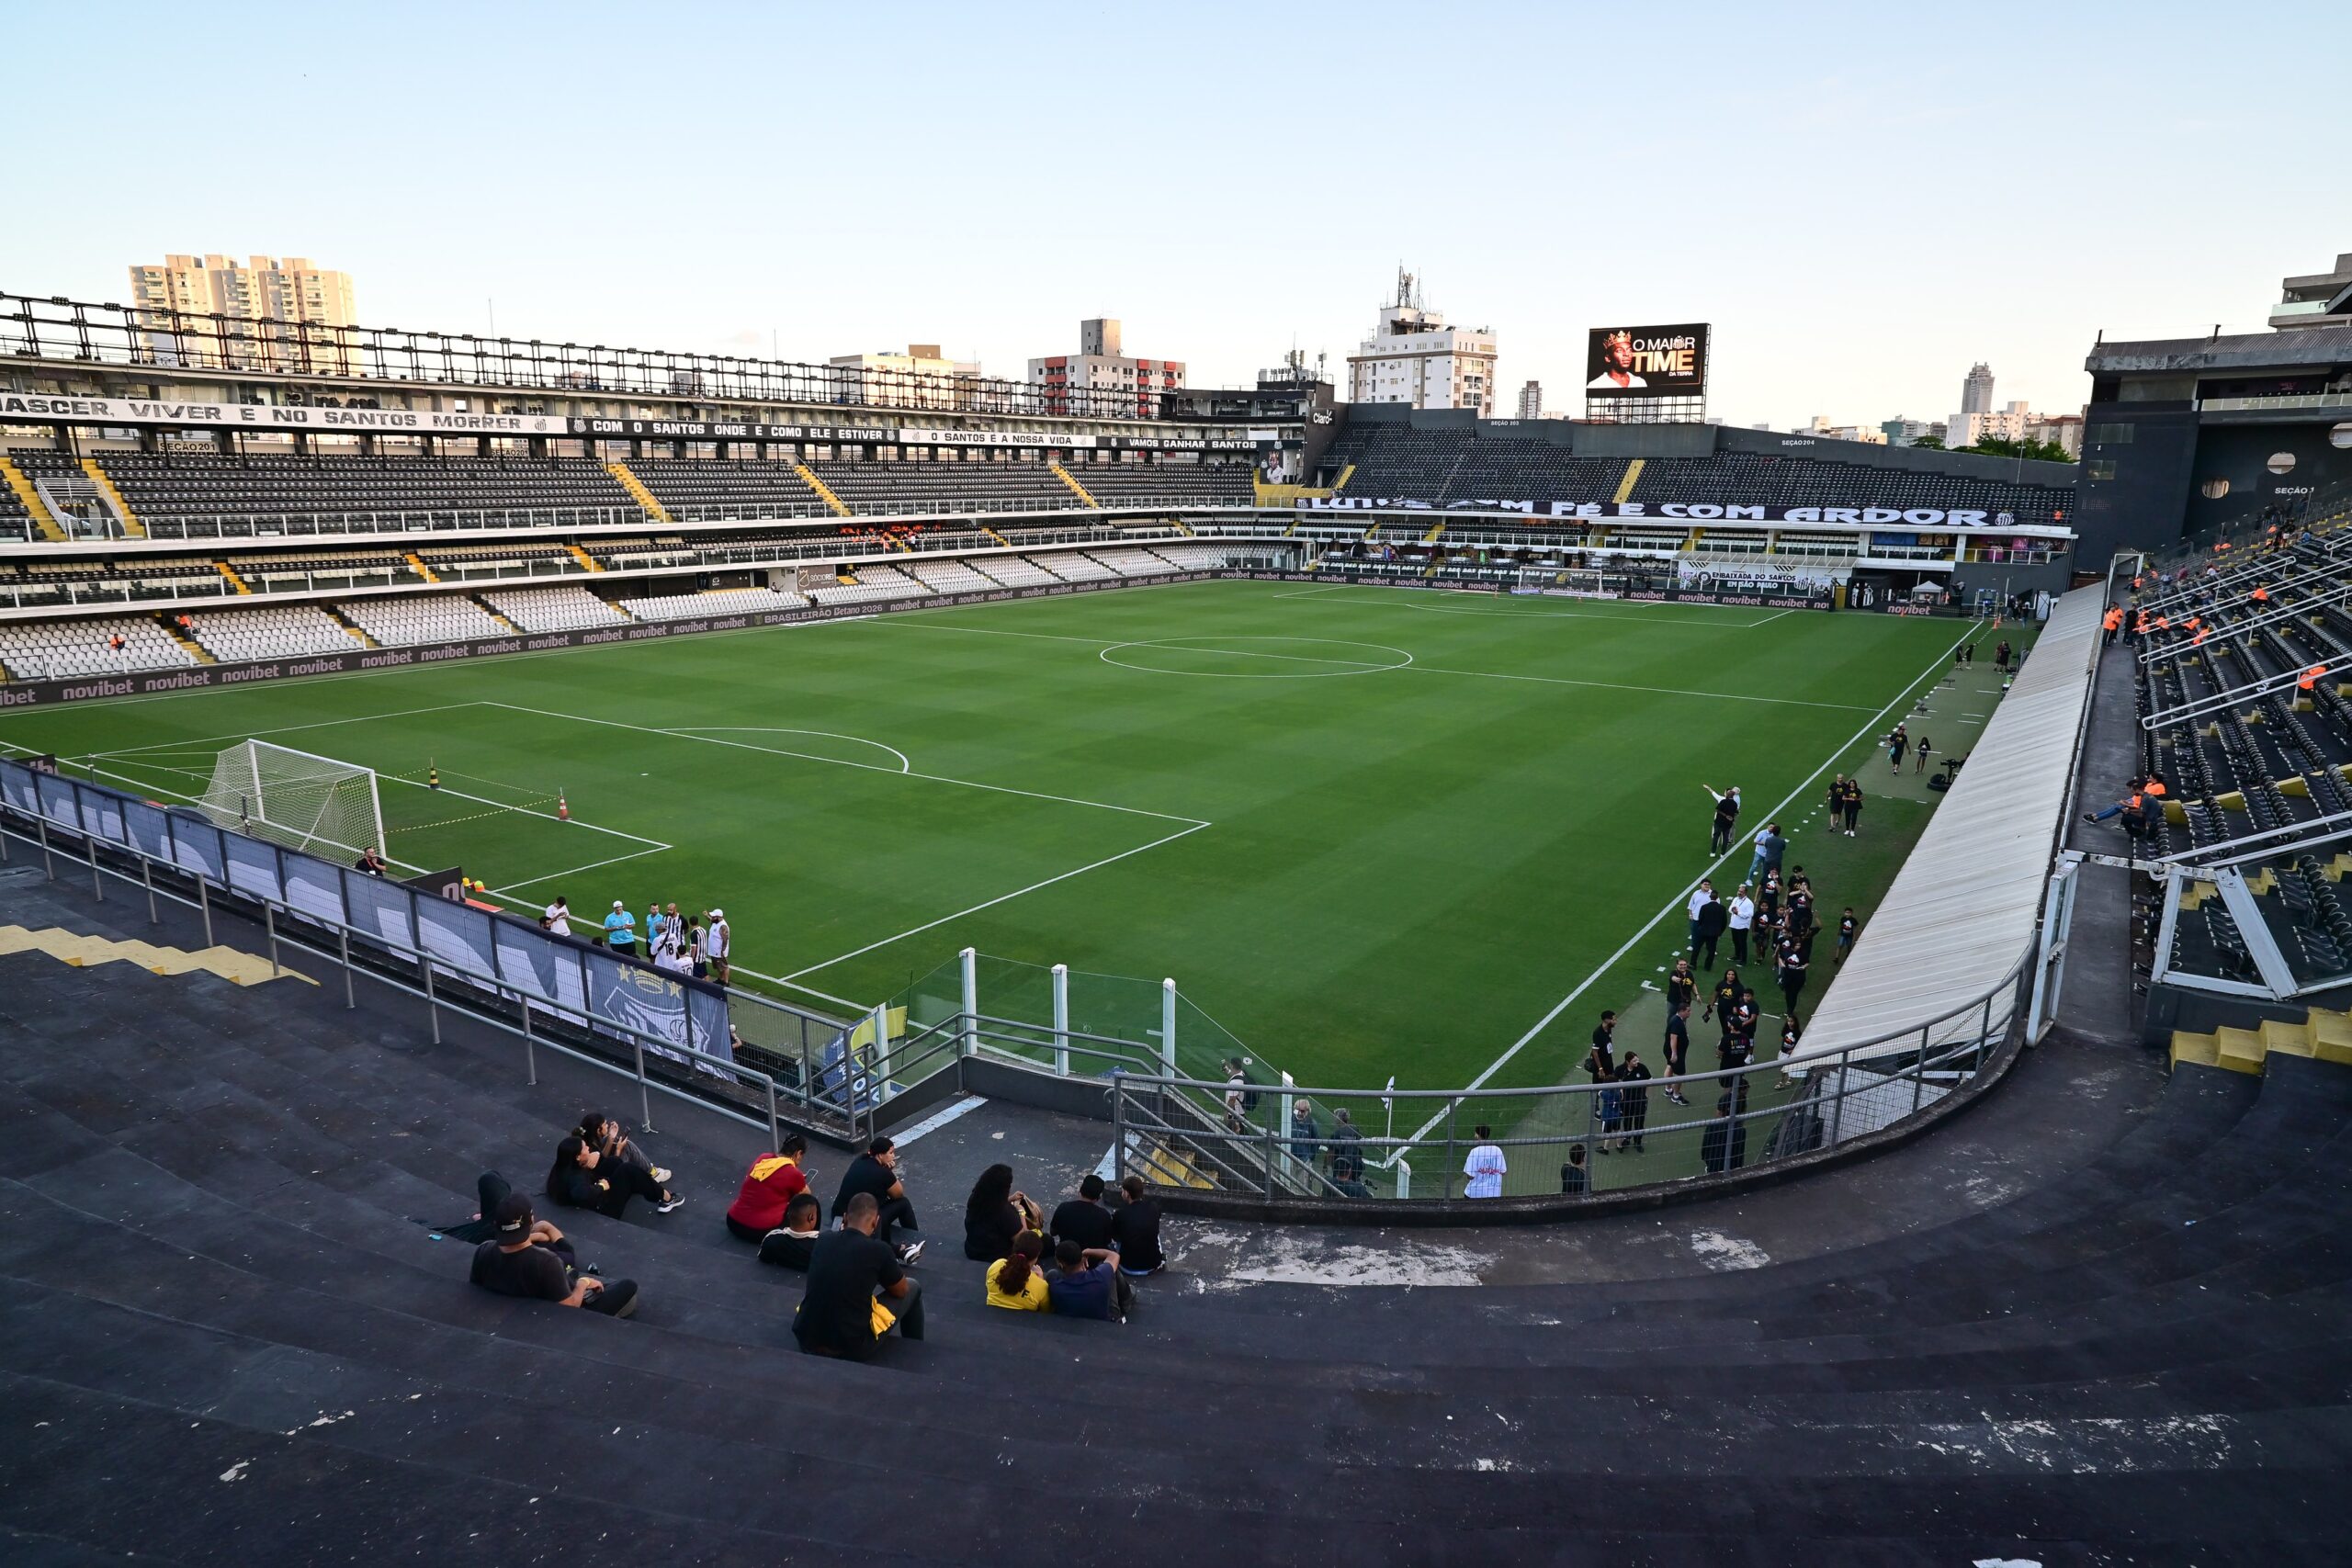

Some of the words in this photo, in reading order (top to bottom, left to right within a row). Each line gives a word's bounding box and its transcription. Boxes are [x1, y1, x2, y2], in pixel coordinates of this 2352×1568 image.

[1633, 339, 1645, 351] O
[1633, 350, 1694, 372] TIME
[0, 398, 114, 417] ASCER,
[129, 403, 221, 420] VIVER
[241, 408, 255, 422] E
[273, 409, 308, 423] NO
[325, 411, 417, 426] SANTOS
[433, 414, 521, 429] MORRER
[1313, 412, 1330, 424] Claro
[593, 421, 623, 433] COM
[633, 422, 642, 433] O
[652, 423, 705, 434] SANTOS
[715, 424, 746, 436] ONDE
[755, 425, 763, 436] E
[771, 426, 802, 437] COMO
[809, 427, 831, 438] ELE
[838, 429, 883, 440] ESTIVER
[931, 433, 938, 441] O
[944, 433, 985, 443] SANTOS
[1001, 434, 1008, 443] A
[1012, 434, 1044, 444] NOSSA
[1049, 435, 1072, 446] VIDA
[1129, 438, 1159, 447] VAMOS
[1163, 439, 1205, 448] GANHAR
[1212, 440, 1257, 449] SANTOS
[1551, 502, 1603, 517] FÉ
[1618, 503, 1645, 516] E
[1660, 503, 1765, 520] COM
[1783, 506, 1989, 526] ARDOR
[1254, 571, 1280, 581] novibet
[1285, 572, 1313, 581] novibet
[1317, 574, 1347, 583] novibet
[1357, 576, 1390, 585] novibet
[1395, 577, 1427, 587] novibet
[1432, 580, 1464, 589] novibet
[1468, 581, 1499, 591] novibet
[1630, 590, 1667, 600] novibet
[1678, 592, 1716, 604] novibet
[1722, 595, 1761, 605] novibet
[1768, 597, 1807, 608] novibet
[62, 680, 134, 700] novibet
[145, 672, 210, 690] novibet
[221, 664, 279, 682] novibet
[289, 657, 343, 676] novibet
[361, 649, 413, 668] novibet
[421, 645, 469, 661] novibet
[477, 639, 521, 655] novibet
[527, 634, 570, 649] novibet
[582, 628, 624, 644] novibet
[628, 624, 667, 639] novibet
[673, 620, 708, 635] novibet
[713, 616, 746, 630] novibet
[764, 608, 831, 624] BRASILEIRÃO
[834, 606, 860, 616] Betano
[862, 604, 883, 614] 2026
[889, 600, 921, 612] novibet
[924, 596, 954, 608] novibet
[958, 592, 985, 604] novibet
[988, 590, 1013, 602] novibet
[1021, 586, 1046, 597] novibet
[1048, 584, 1073, 595] novibet
[1076, 581, 1098, 592] novibet
[1101, 580, 1122, 589] novibet
[1127, 577, 1148, 587] novibet
[1150, 575, 1170, 584] novibet
[1172, 573, 1192, 582] novibet
[1193, 571, 1211, 580] novibet
[664, 942, 673, 956] 18
